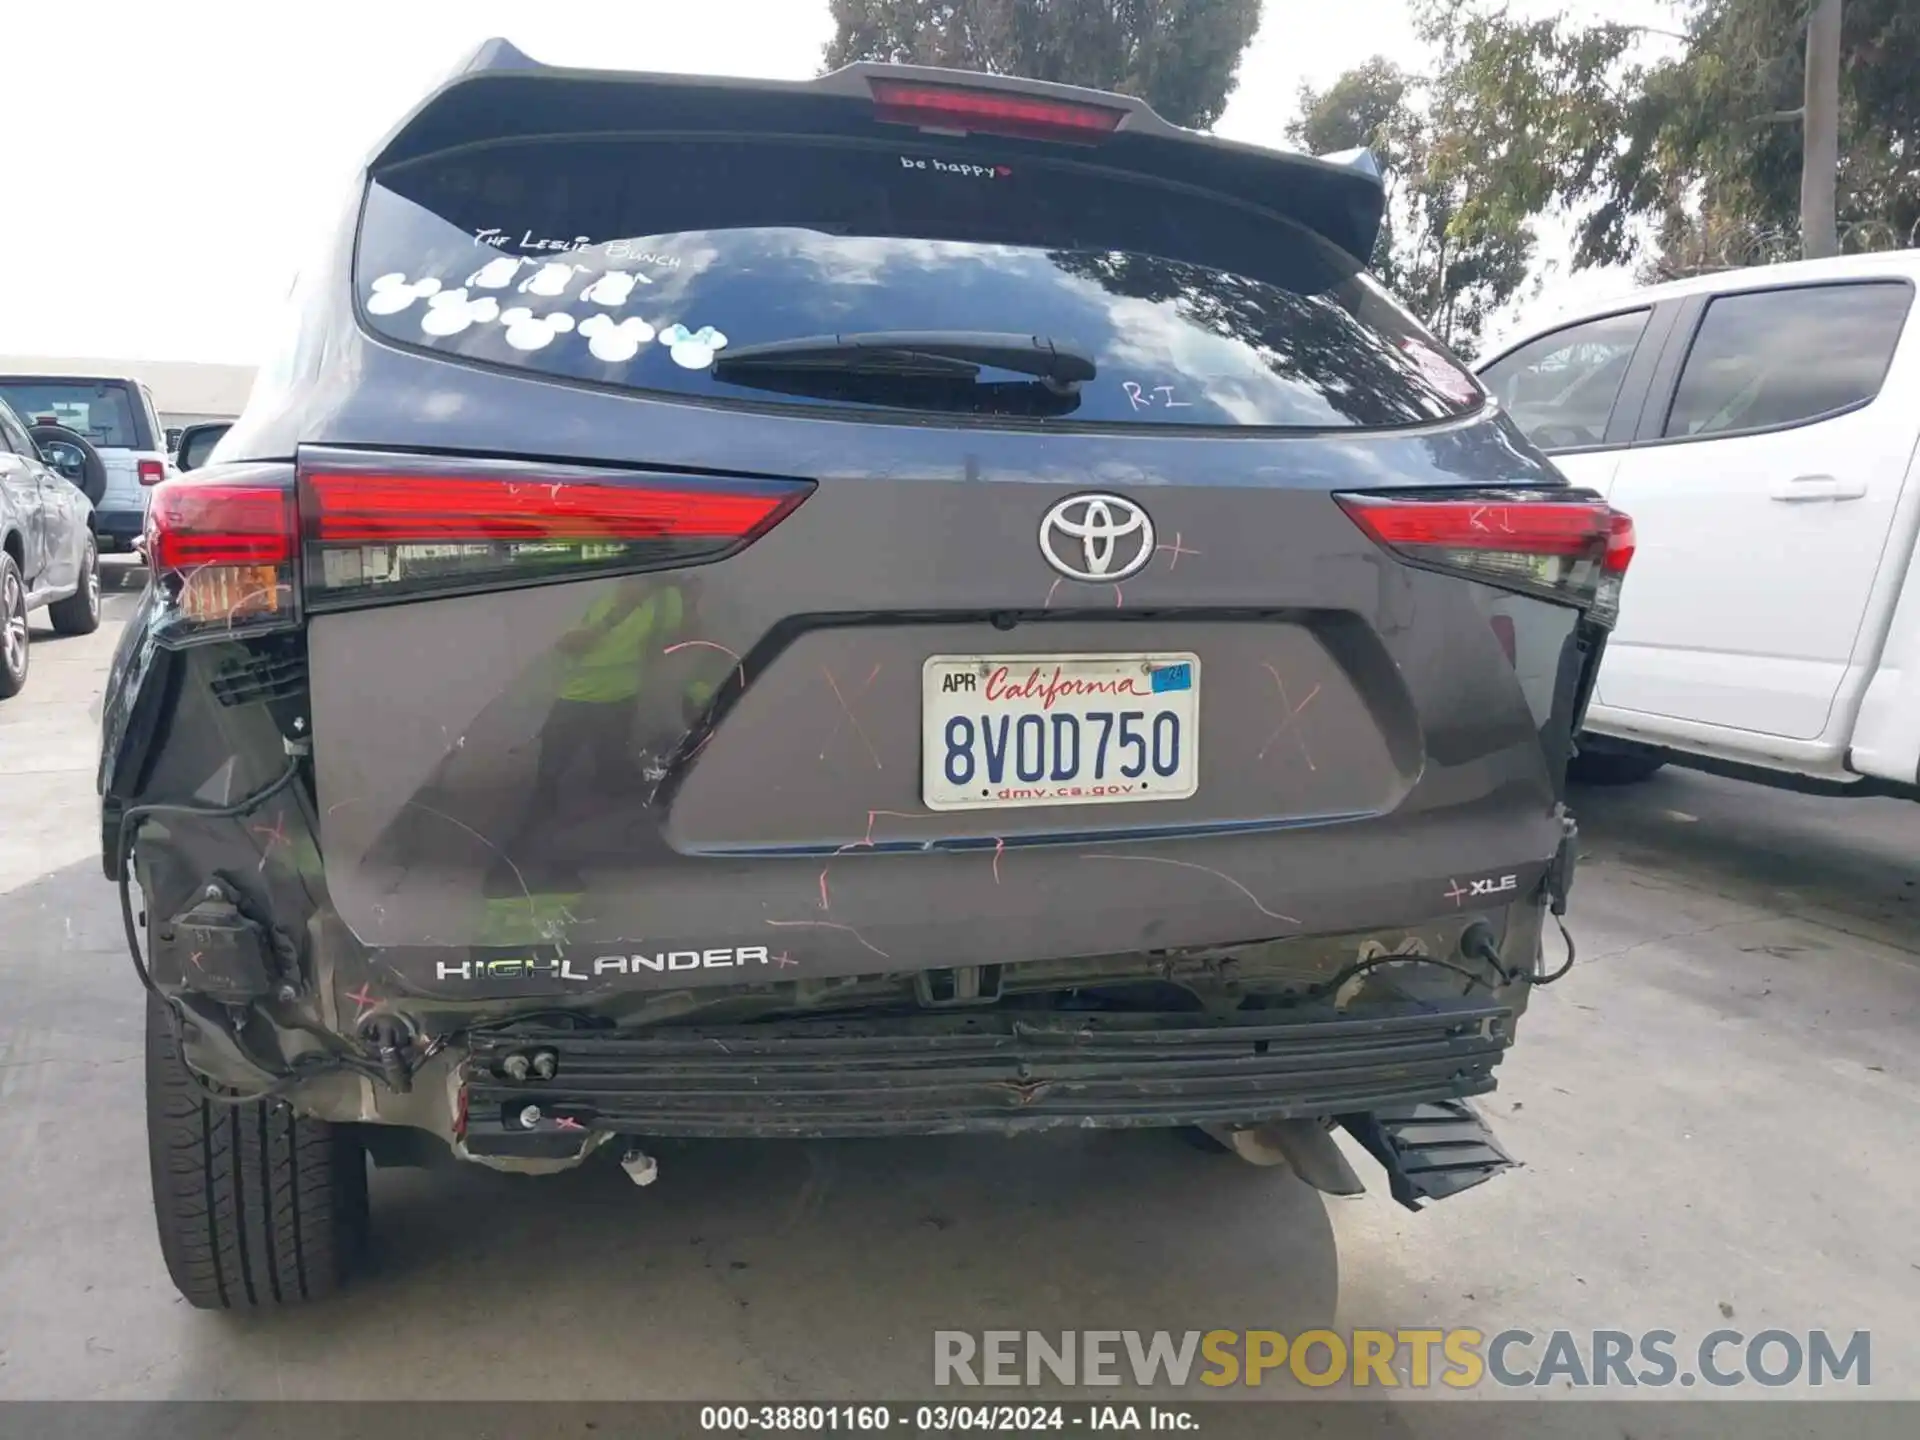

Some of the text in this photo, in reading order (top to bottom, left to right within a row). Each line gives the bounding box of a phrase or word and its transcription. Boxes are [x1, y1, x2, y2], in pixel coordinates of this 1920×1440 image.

[900, 156, 995, 178] be happy
[942, 673, 977, 693] APR
[985, 666, 1152, 710] California
[997, 783, 1134, 800] dmv.ca.gov
[1470, 874, 1518, 896] XLE
[436, 946, 770, 981] HIGHLANDER
